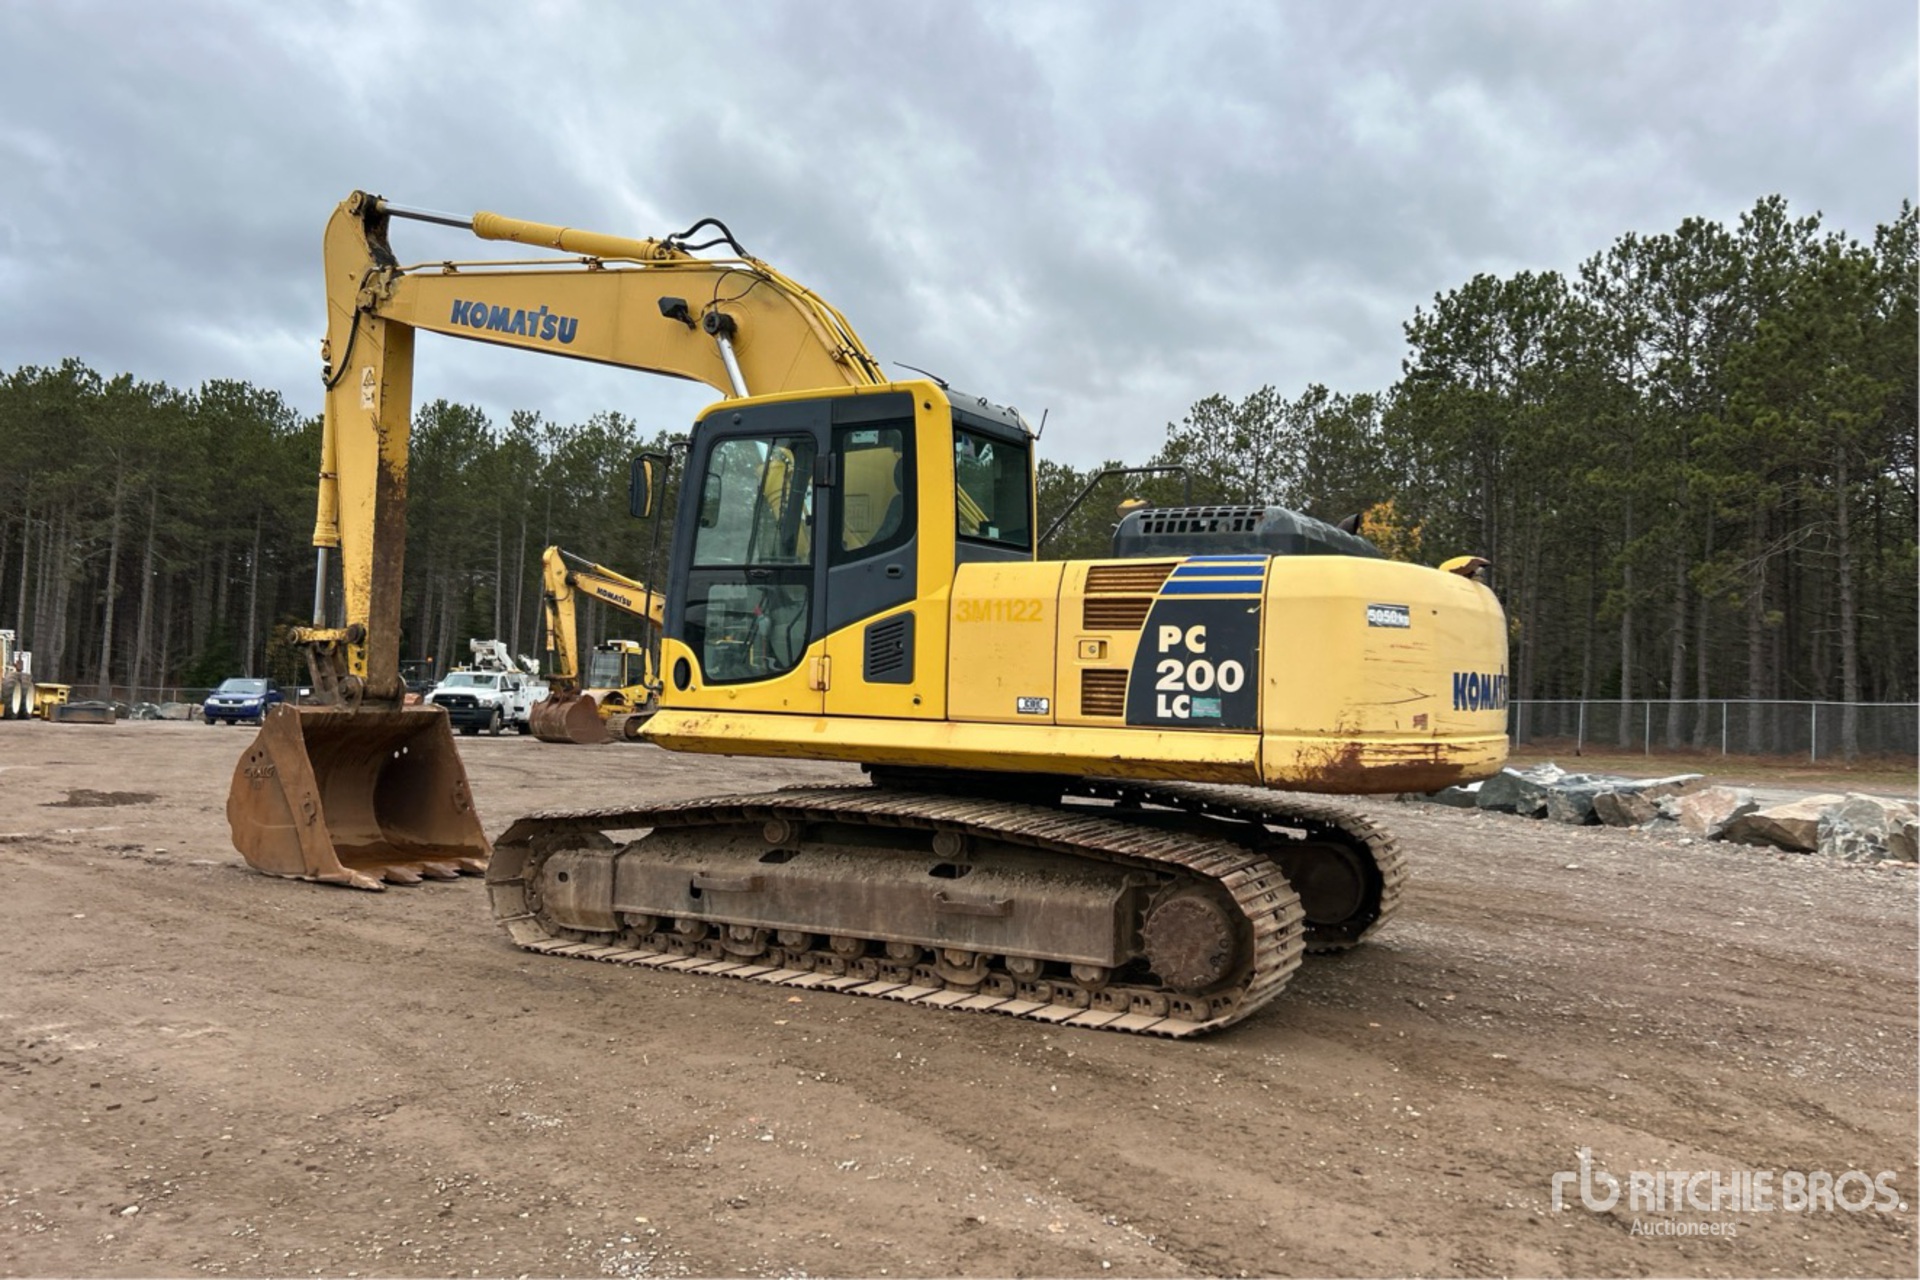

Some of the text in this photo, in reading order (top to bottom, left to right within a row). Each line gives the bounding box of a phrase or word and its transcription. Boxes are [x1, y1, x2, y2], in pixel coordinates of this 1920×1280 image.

[451, 299, 578, 344] KOMATSU
[596, 586, 632, 607] KOMATSU
[956, 599, 1043, 622] 3M1122
[1158, 625, 1206, 653] PC
[1155, 658, 1244, 693] 200
[1157, 694, 1190, 718] LC
